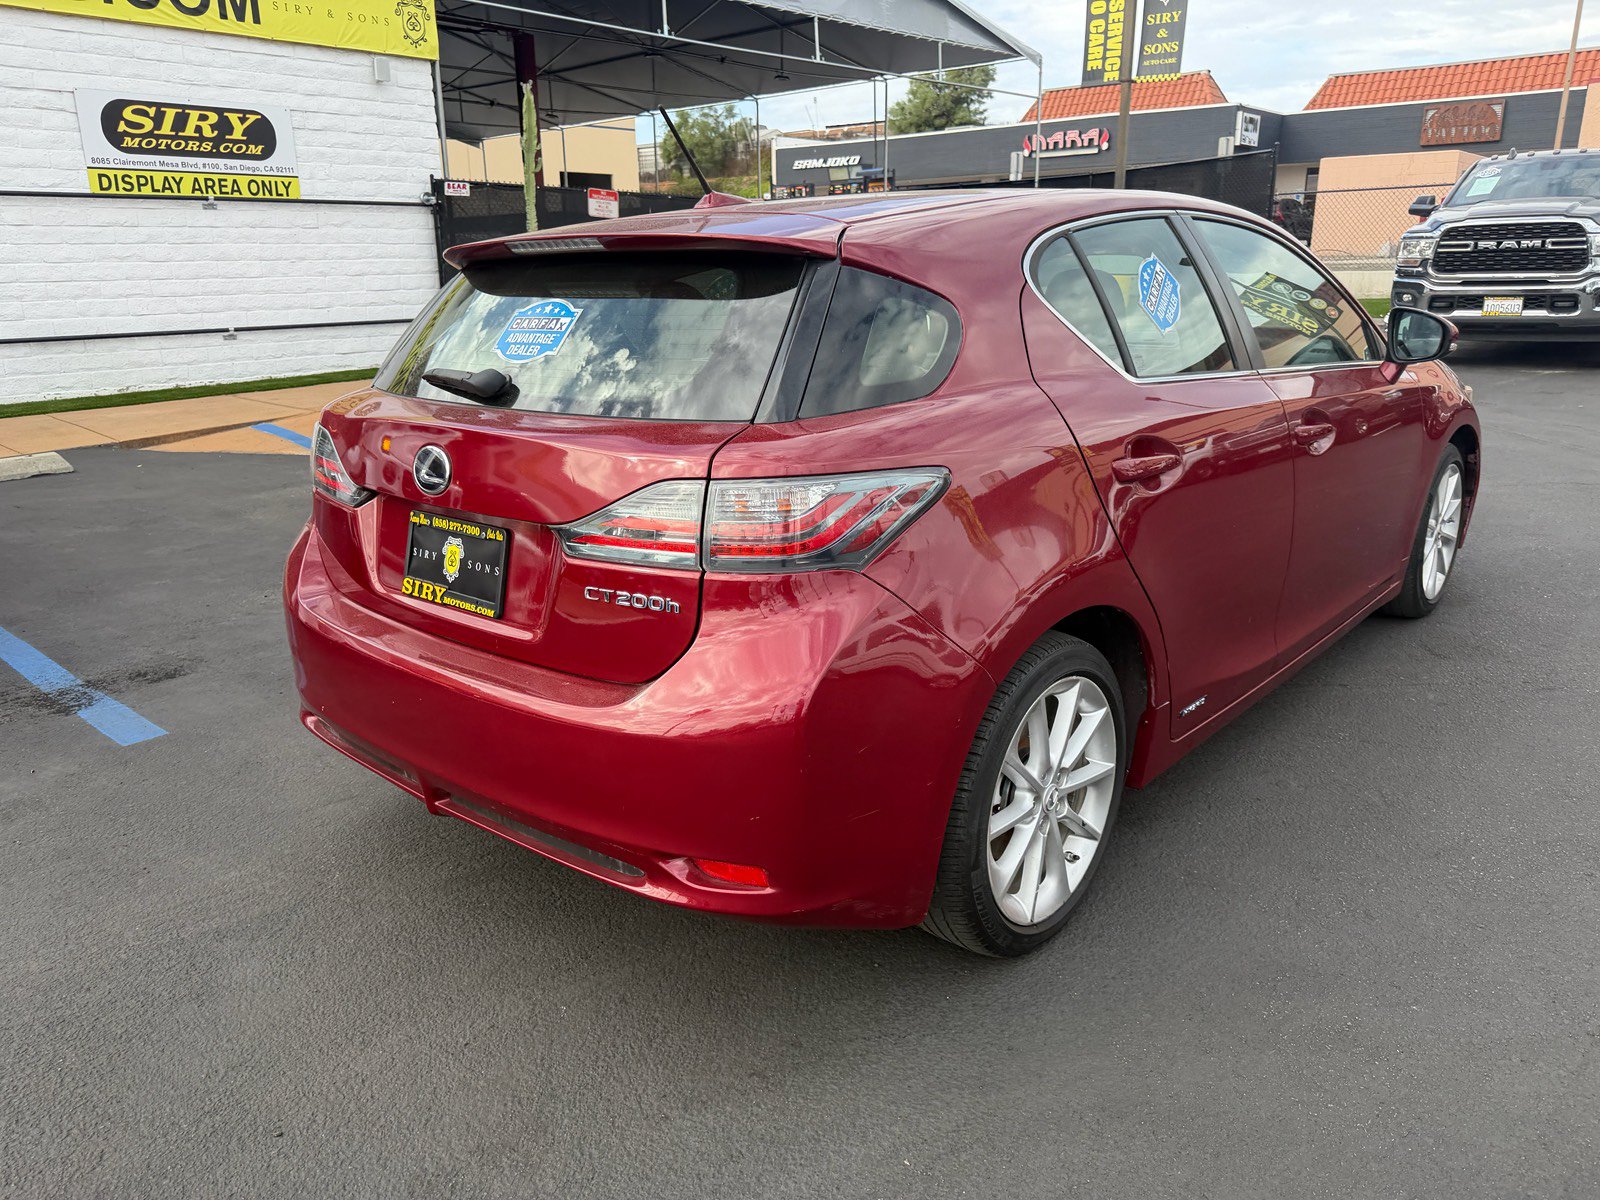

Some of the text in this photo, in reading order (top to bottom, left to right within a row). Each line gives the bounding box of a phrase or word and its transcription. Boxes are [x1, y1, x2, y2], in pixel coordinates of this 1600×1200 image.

[272, 1, 313, 15] SIRY
[327, 9, 335, 19] &
[347, 12, 390, 26] SONS
[1146, 11, 1182, 26] SIRY
[1103, 0, 1125, 82] SERVICE
[1156, 28, 1169, 38] &
[1087, 19, 1106, 71] CARE
[1143, 41, 1179, 56] SONS
[1160, 57, 1178, 65] CARE
[117, 104, 262, 141] SIRY
[121, 136, 264, 156] MOTORS.COM
[1031, 128, 1100, 151] NARA
[91, 157, 111, 165] 8085
[112, 158, 157, 167] Clairemont
[159, 160, 179, 168] Mesa
[181, 161, 201, 169] Blvd,
[202, 163, 222, 171] #100,
[223, 163, 238, 171] San
[239, 164, 263, 173] Diego,
[275, 166, 295, 174] 92111
[792, 154, 861, 170] SAMJOKO
[97, 173, 292, 197] DISPLAY AREA ONLY
[447, 182, 467, 190] BEAR
[1477, 240, 1542, 250] RAM
[1147, 267, 1166, 312] CARFAX
[1157, 276, 1173, 321] ADVANTAGE
[1165, 293, 1179, 324] DEALER
[511, 318, 568, 331] CARFAX
[506, 334, 556, 344] ADVANTAGE
[506, 344, 541, 356] DEALER
[432, 516, 449, 530] (858)
[449, 521, 480, 536] 277-7300
[413, 547, 500, 576] SIRY SONS
[401, 577, 447, 604] SIRY
[584, 586, 680, 614] CT200h
[443, 596, 495, 618] MOTORS.COM
